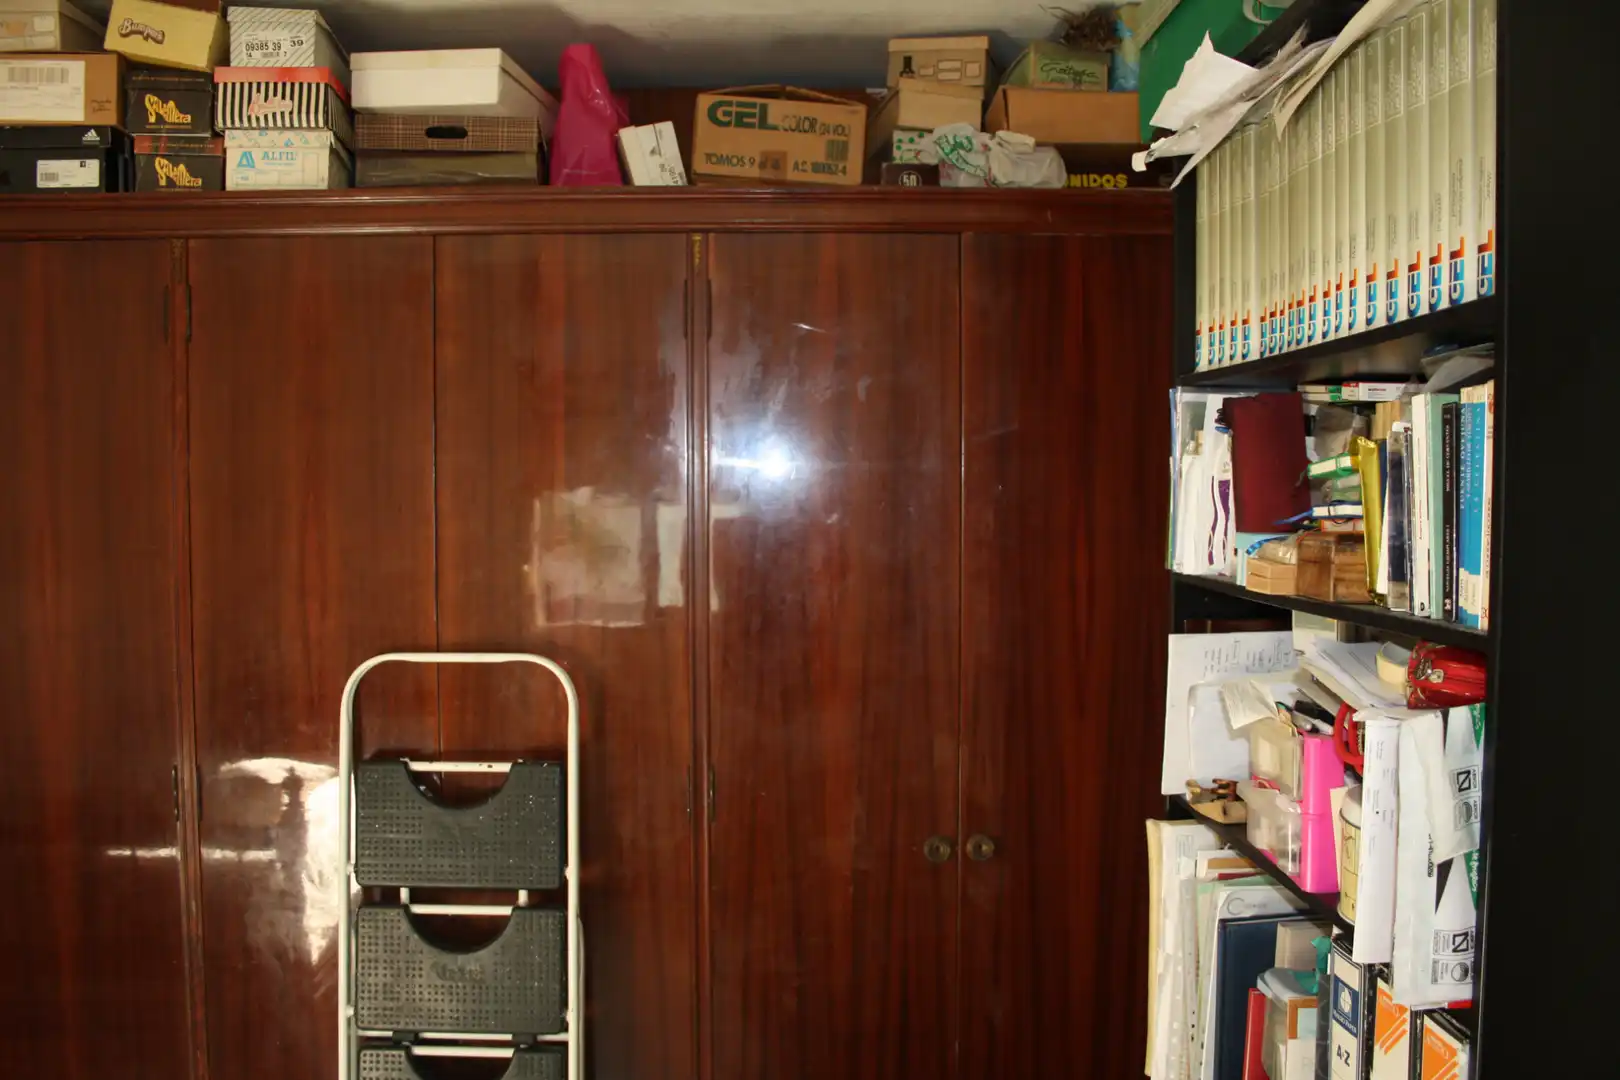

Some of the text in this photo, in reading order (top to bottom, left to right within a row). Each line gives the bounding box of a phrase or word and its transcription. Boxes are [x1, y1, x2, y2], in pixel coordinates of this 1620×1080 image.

[245, 42, 281, 52] 09385 39
[290, 39, 304, 48] 39
[707, 99, 780, 131] GEL
[781, 114, 817, 134] COLOR
[704, 152, 746, 168] TOMOS
[1066, 173, 1128, 188] NIDOS
[1386, 258, 1399, 325] GEL
[1407, 250, 1421, 317] GEL
[1428, 242, 1442, 313] GEL
[1448, 236, 1464, 305] GEL
[1477, 229, 1493, 299] GEL
[1296, 288, 1306, 346] GEL
[1308, 284, 1317, 342] GEL
[1322, 279, 1331, 339] GEL
[1335, 271, 1343, 333] GEL
[1349, 268, 1357, 331] GEL
[1366, 262, 1377, 327] GEL
[1336, 1044, 1350, 1067] A-Z
